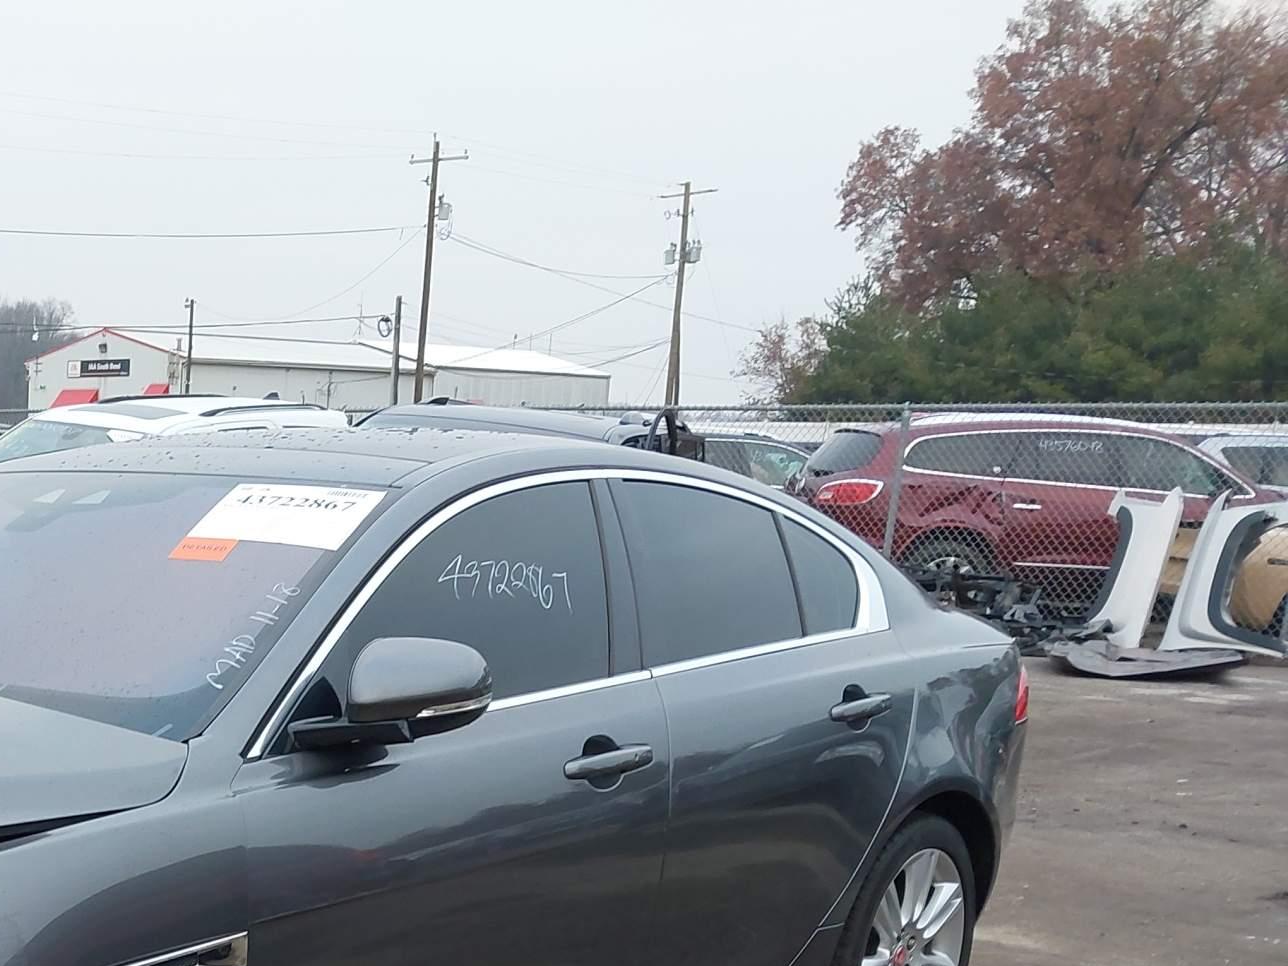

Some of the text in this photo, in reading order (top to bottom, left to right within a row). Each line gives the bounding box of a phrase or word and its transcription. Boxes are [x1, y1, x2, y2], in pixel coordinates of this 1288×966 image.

[236, 493, 358, 512] 43722867
[437, 553, 575, 617] 43722867
[205, 634, 256, 690] MAD
